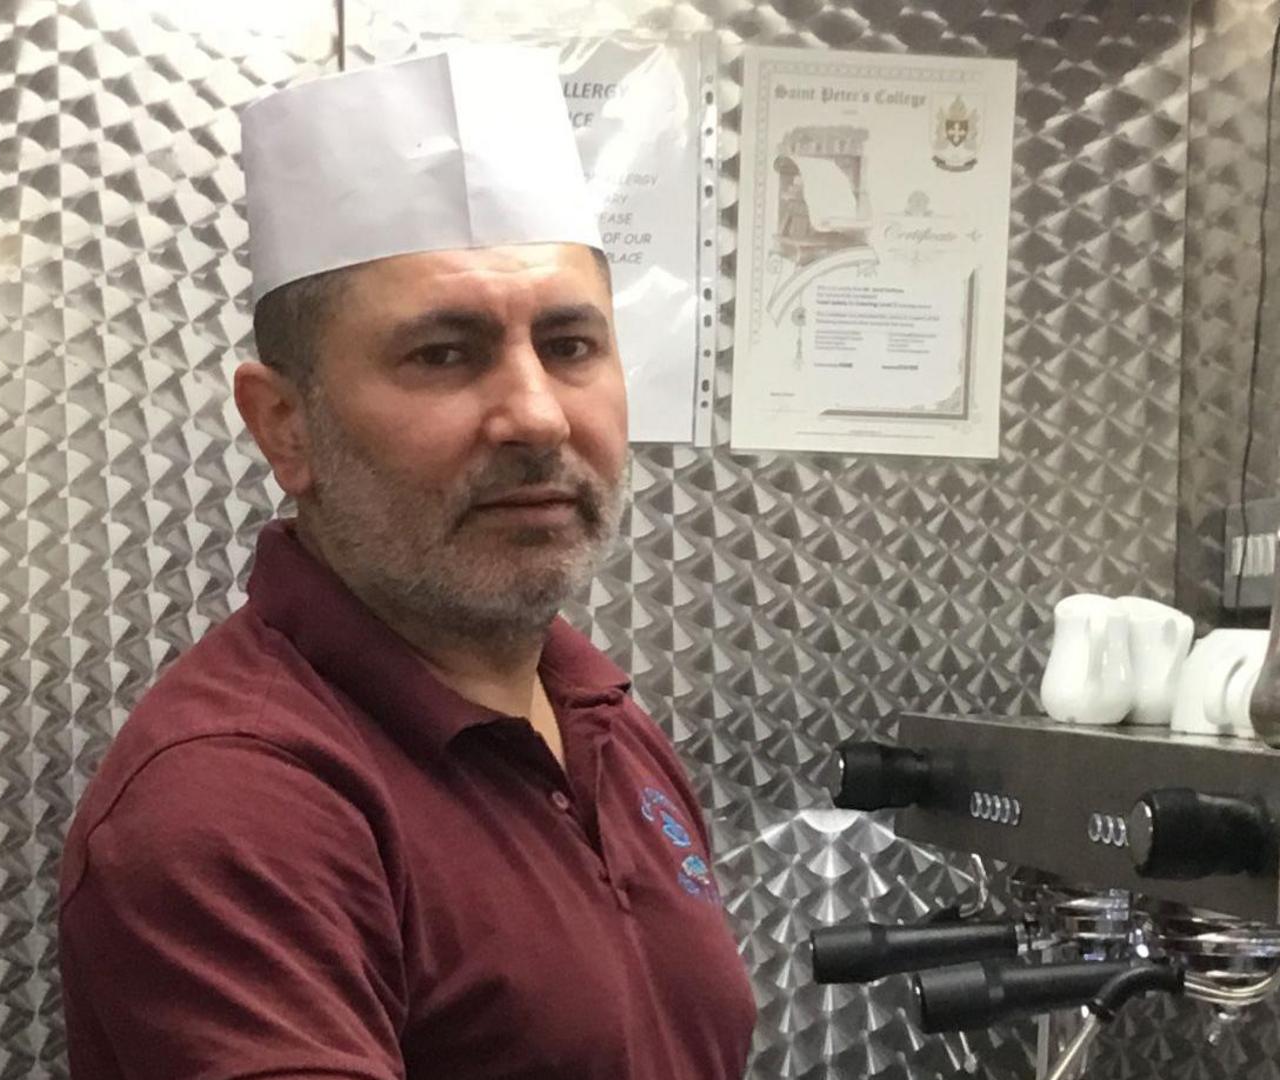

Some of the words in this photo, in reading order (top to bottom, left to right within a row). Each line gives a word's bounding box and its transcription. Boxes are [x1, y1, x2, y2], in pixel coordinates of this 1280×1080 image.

[562, 82, 630, 99] LLERGY
[774, 84, 815, 100] Saint
[874, 88, 927, 109] College
[599, 211, 633, 225] EASE
[624, 233, 652, 245] OUR
